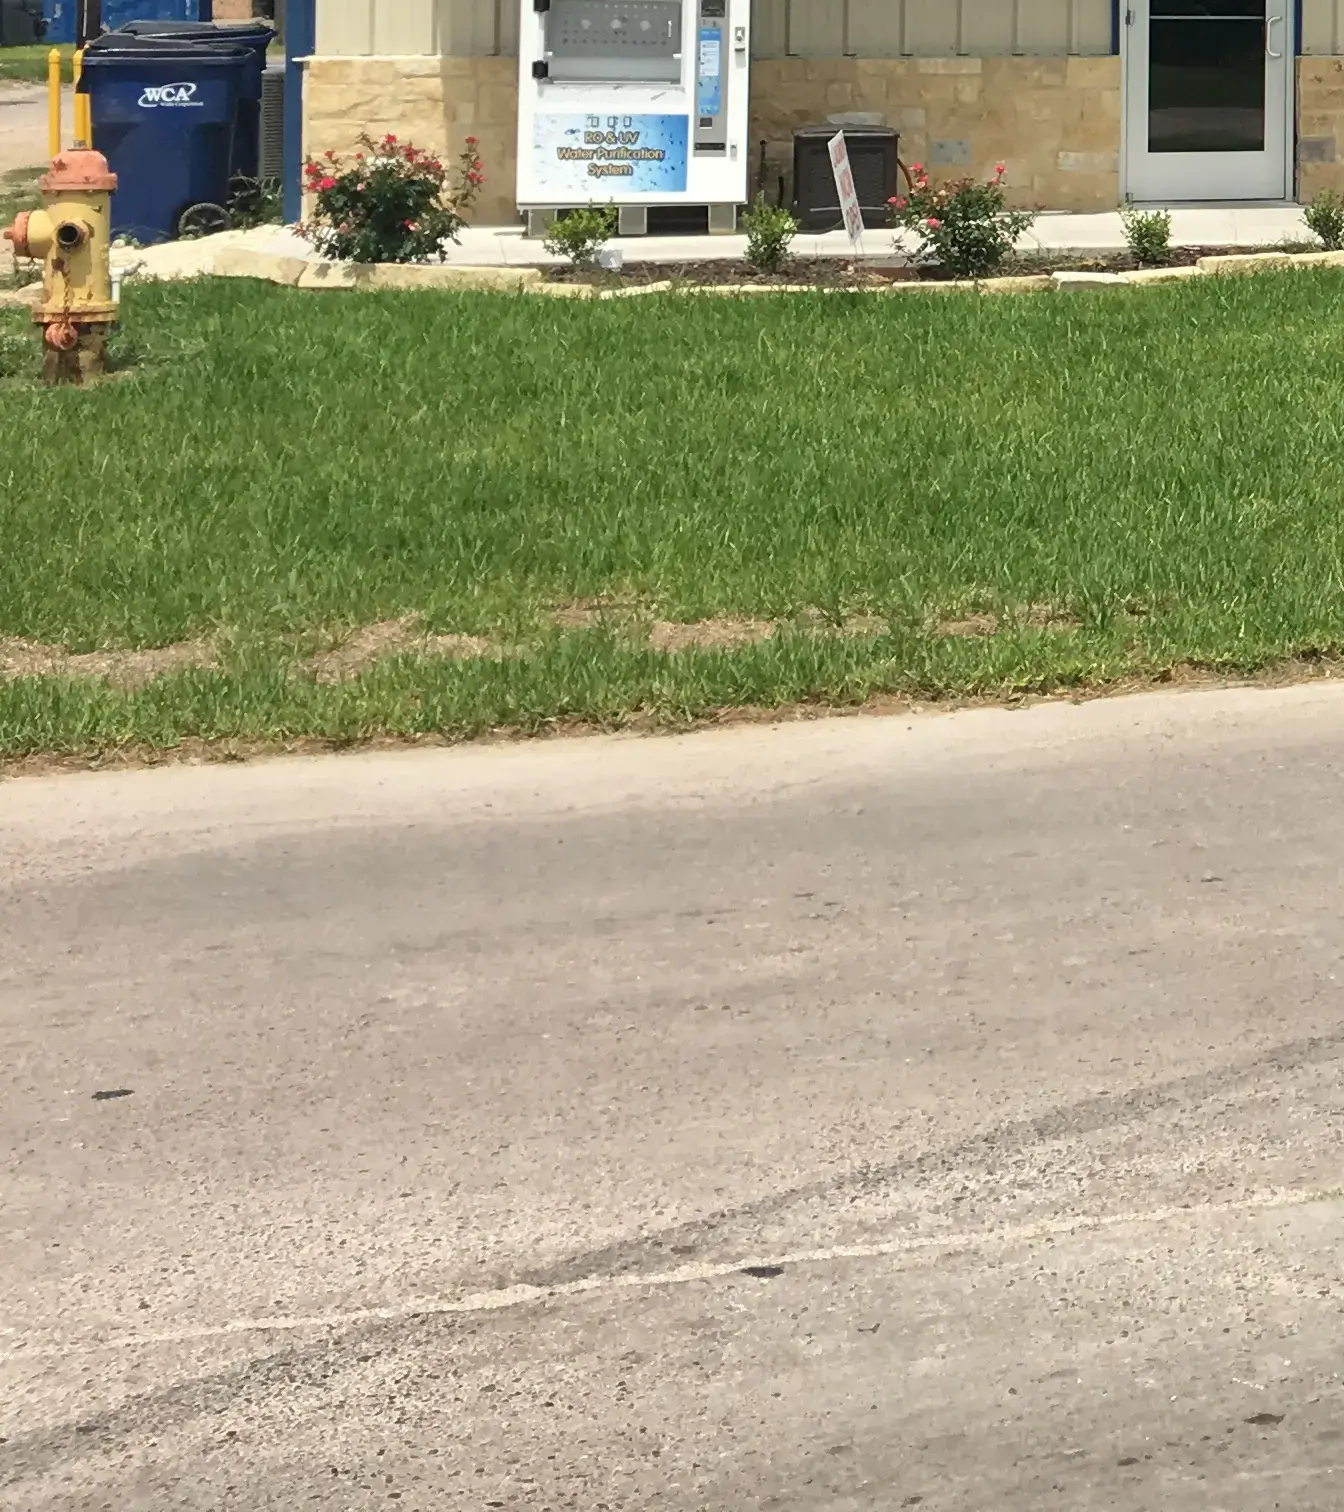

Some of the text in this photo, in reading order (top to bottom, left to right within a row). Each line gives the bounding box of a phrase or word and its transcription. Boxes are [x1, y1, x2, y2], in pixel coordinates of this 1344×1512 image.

[143, 87, 190, 102] WCA
[584, 131, 640, 145] RO & UV
[557, 146, 665, 161] Water Purification
[587, 163, 633, 178] System
